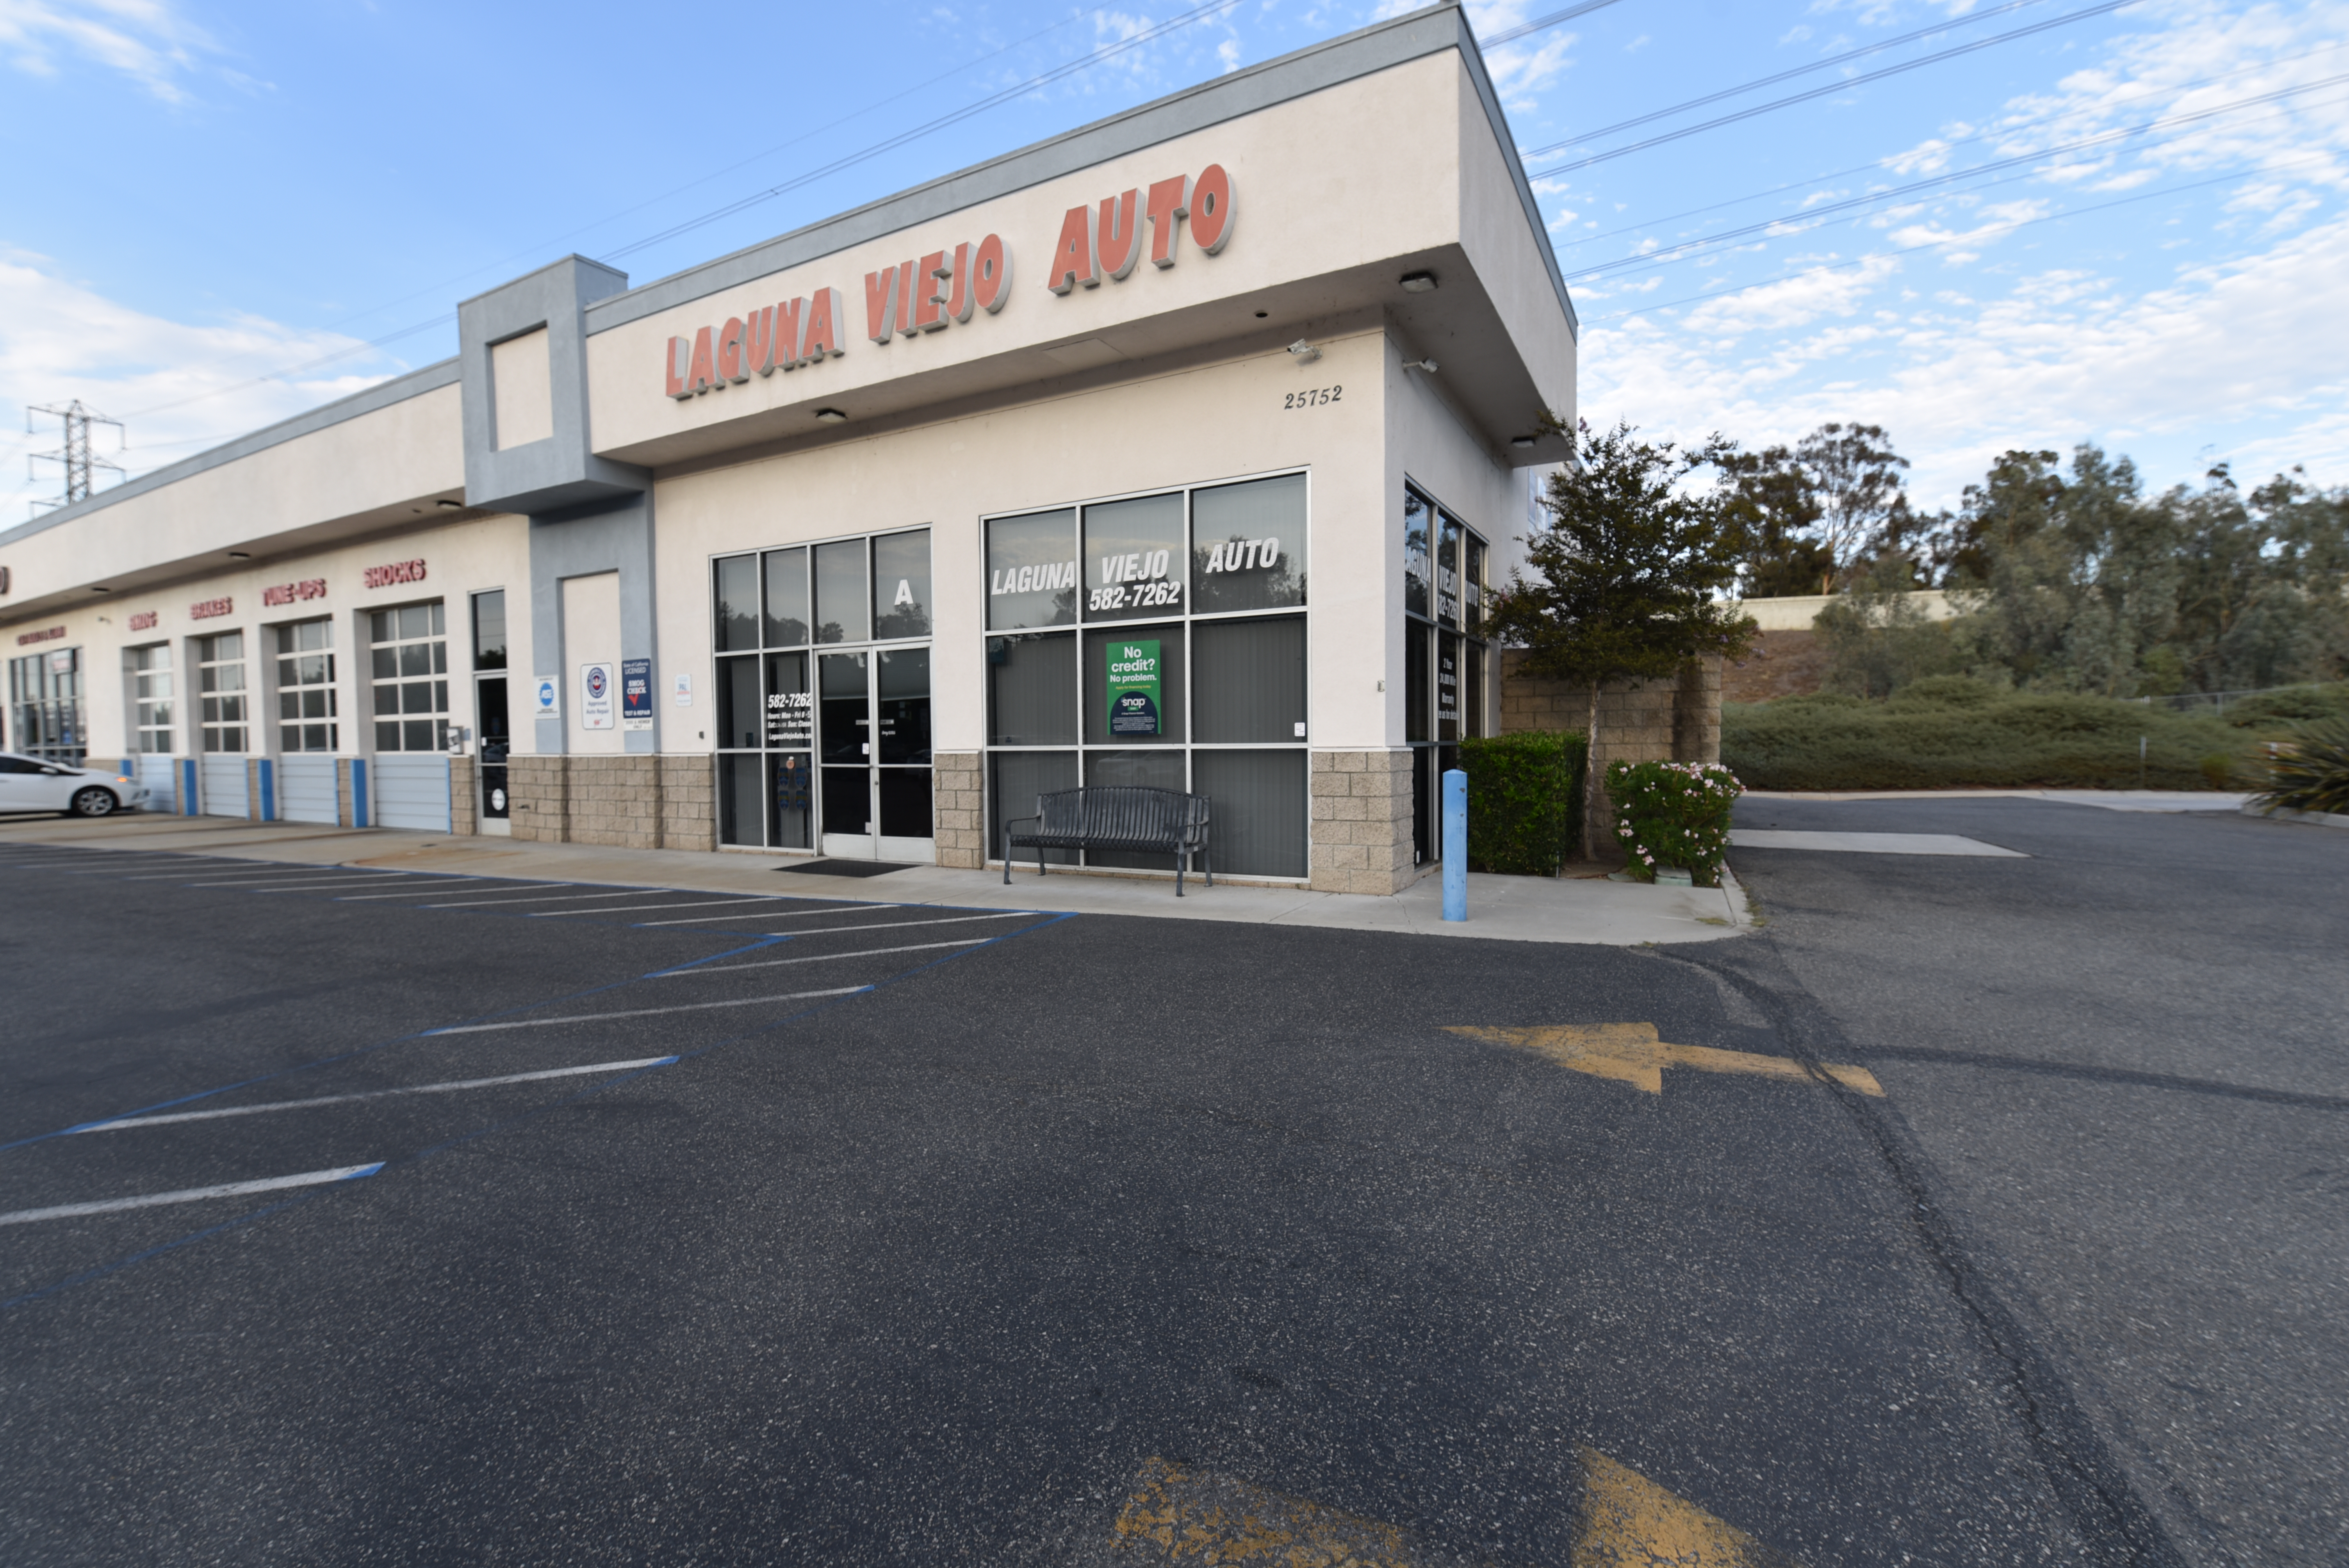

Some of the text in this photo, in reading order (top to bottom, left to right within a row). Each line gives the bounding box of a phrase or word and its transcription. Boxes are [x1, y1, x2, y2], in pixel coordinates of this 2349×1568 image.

[666, 163, 1237, 400] LAGUNA VIEJO AUTO
[1284, 385, 1342, 410] 25752
[364, 559, 426, 588] SHOCKS
[992, 537, 1280, 595] LAGUNA VIEJO AUTO
[1406, 546, 1431, 583] AGUNA
[1439, 565, 1457, 596] VIEJO
[262, 578, 326, 606] TUNE-UPS
[894, 579, 914, 605] A
[1089, 581, 1181, 611] 582-7262
[190, 597, 233, 620] BRAKES
[1439, 594, 1460, 621] 82-7262
[1111, 658, 1155, 672] credit?
[1124, 646, 1142, 659] No
[627, 686, 647, 695] CHECK
[1110, 673, 1157, 684] No problem.
[768, 693, 811, 709] 582-7262
[1122, 698, 1146, 709] snap
[768, 732, 812, 741] LagunaViejoAuto.co
